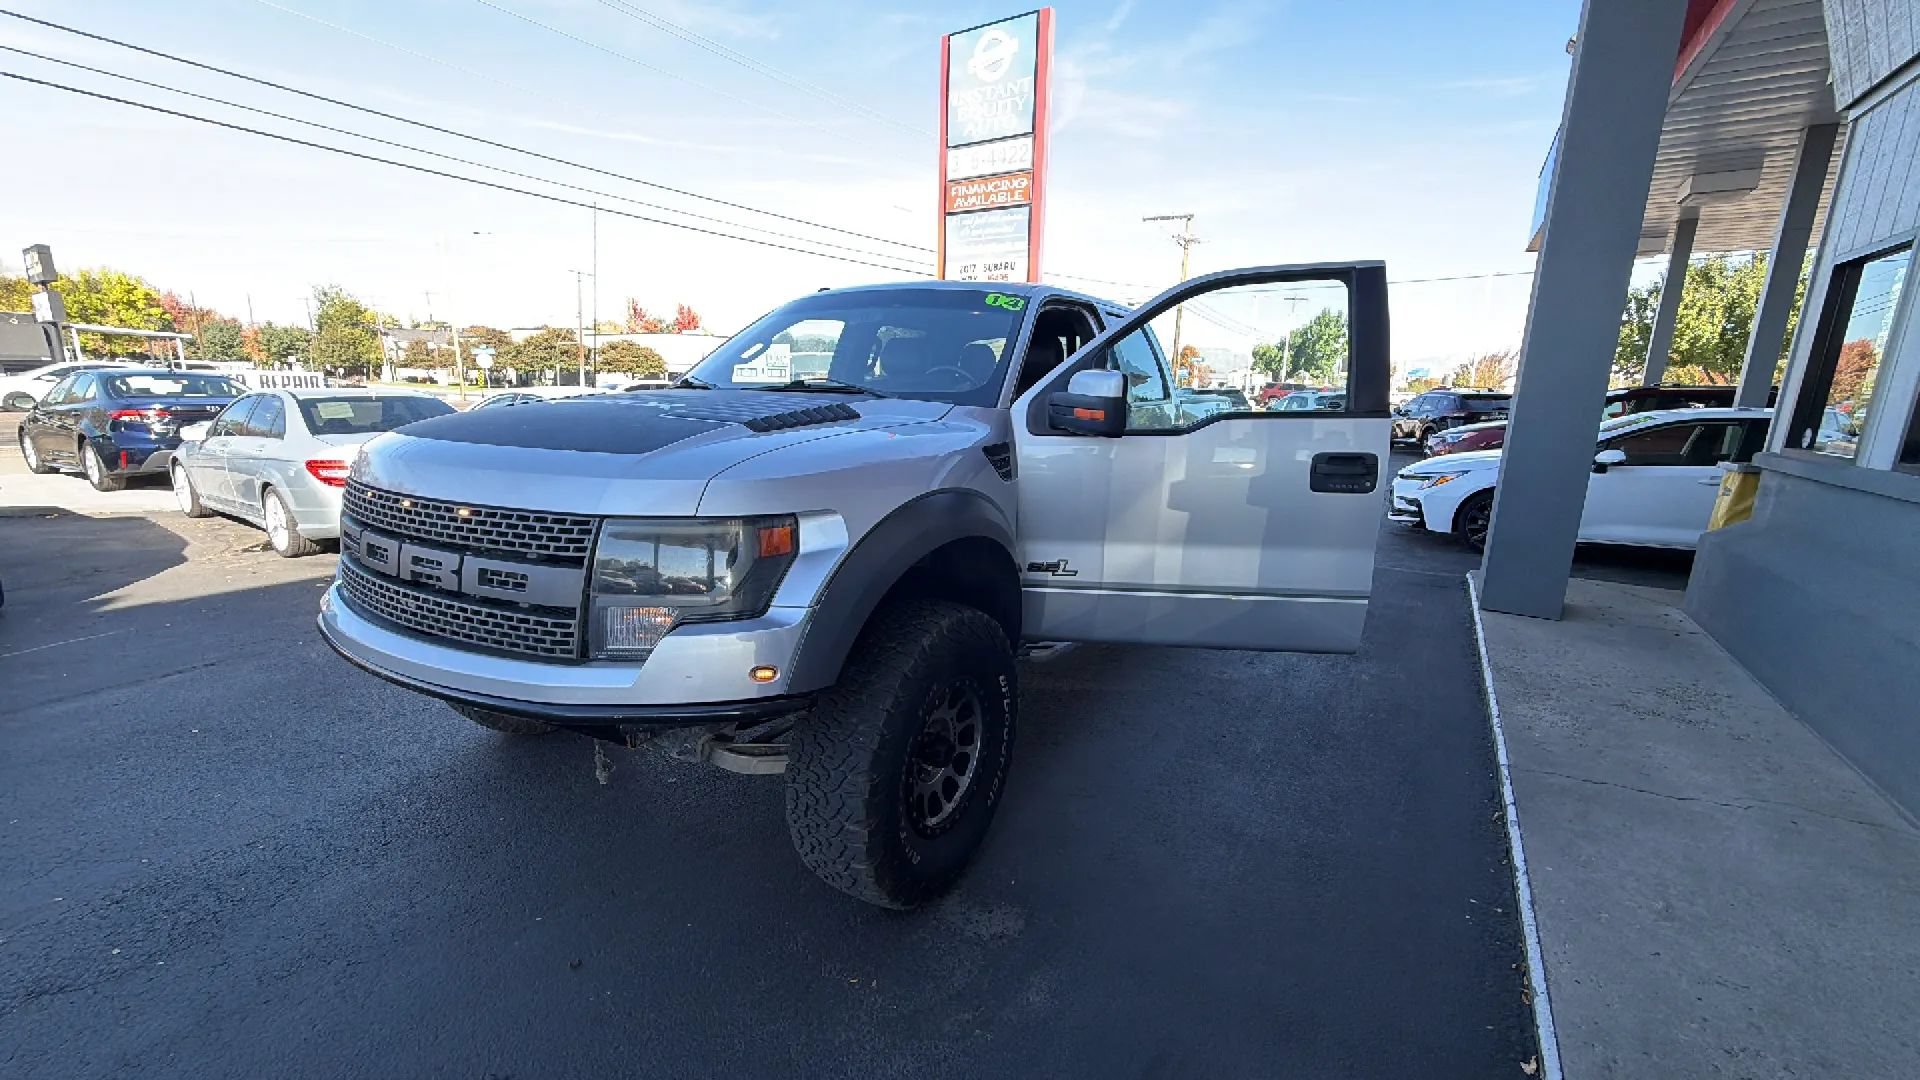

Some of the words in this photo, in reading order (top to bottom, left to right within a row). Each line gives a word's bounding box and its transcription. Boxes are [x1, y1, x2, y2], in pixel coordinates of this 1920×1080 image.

[951, 178, 1028, 196] FINANCING
[953, 190, 1024, 208] AVAILABLE
[959, 263, 977, 275] 2017
[983, 261, 1016, 273] SUBARU
[259, 375, 320, 389] REPAIR
